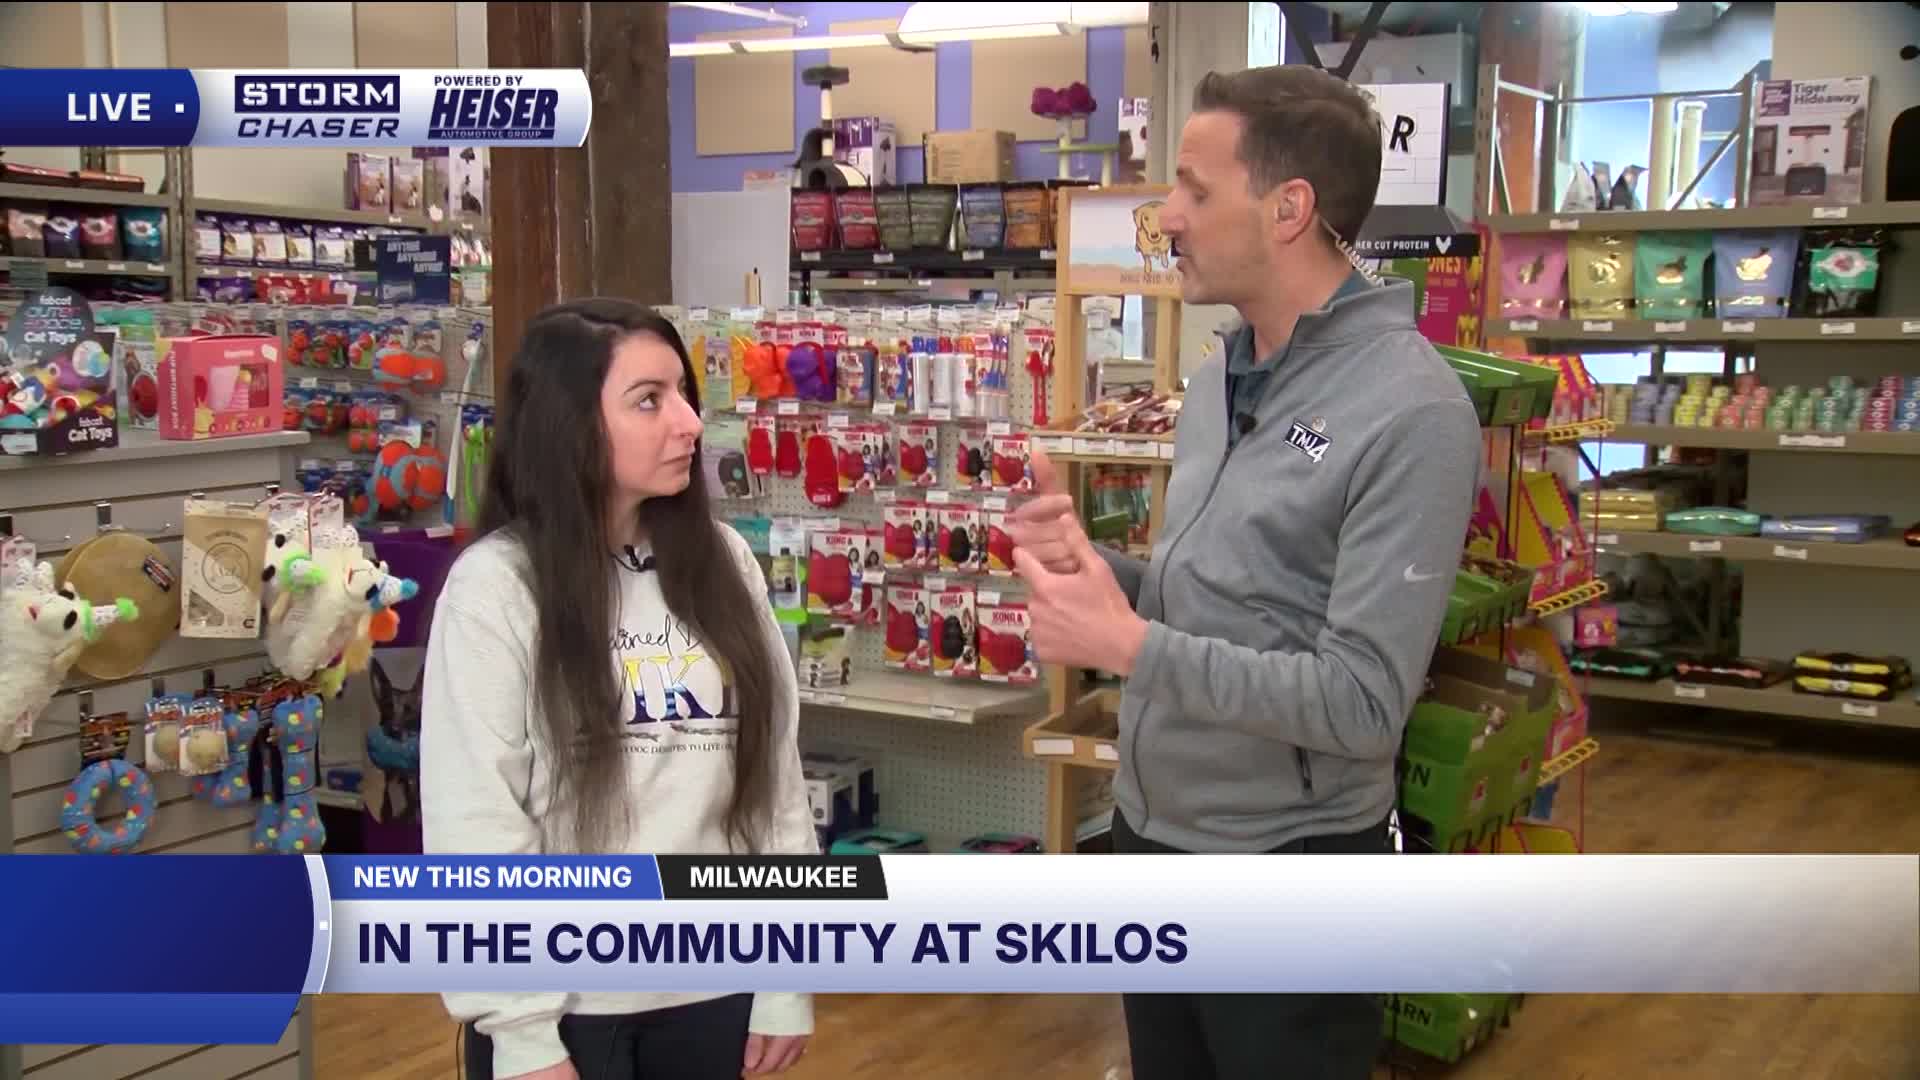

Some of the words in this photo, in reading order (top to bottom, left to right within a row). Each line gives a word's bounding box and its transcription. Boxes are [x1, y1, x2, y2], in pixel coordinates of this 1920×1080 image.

[1794, 83, 1827, 96] Tiger
[1374, 240, 1391, 250] CUT
[1393, 240, 1430, 250] PROTEIN
[24, 331, 46, 343] Cat
[48, 331, 76, 345] Toys
[68, 429, 88, 442] Cat
[88, 426, 113, 441] Toys
[825, 536, 846, 545] KONG
[992, 609, 1015, 623] KONG
